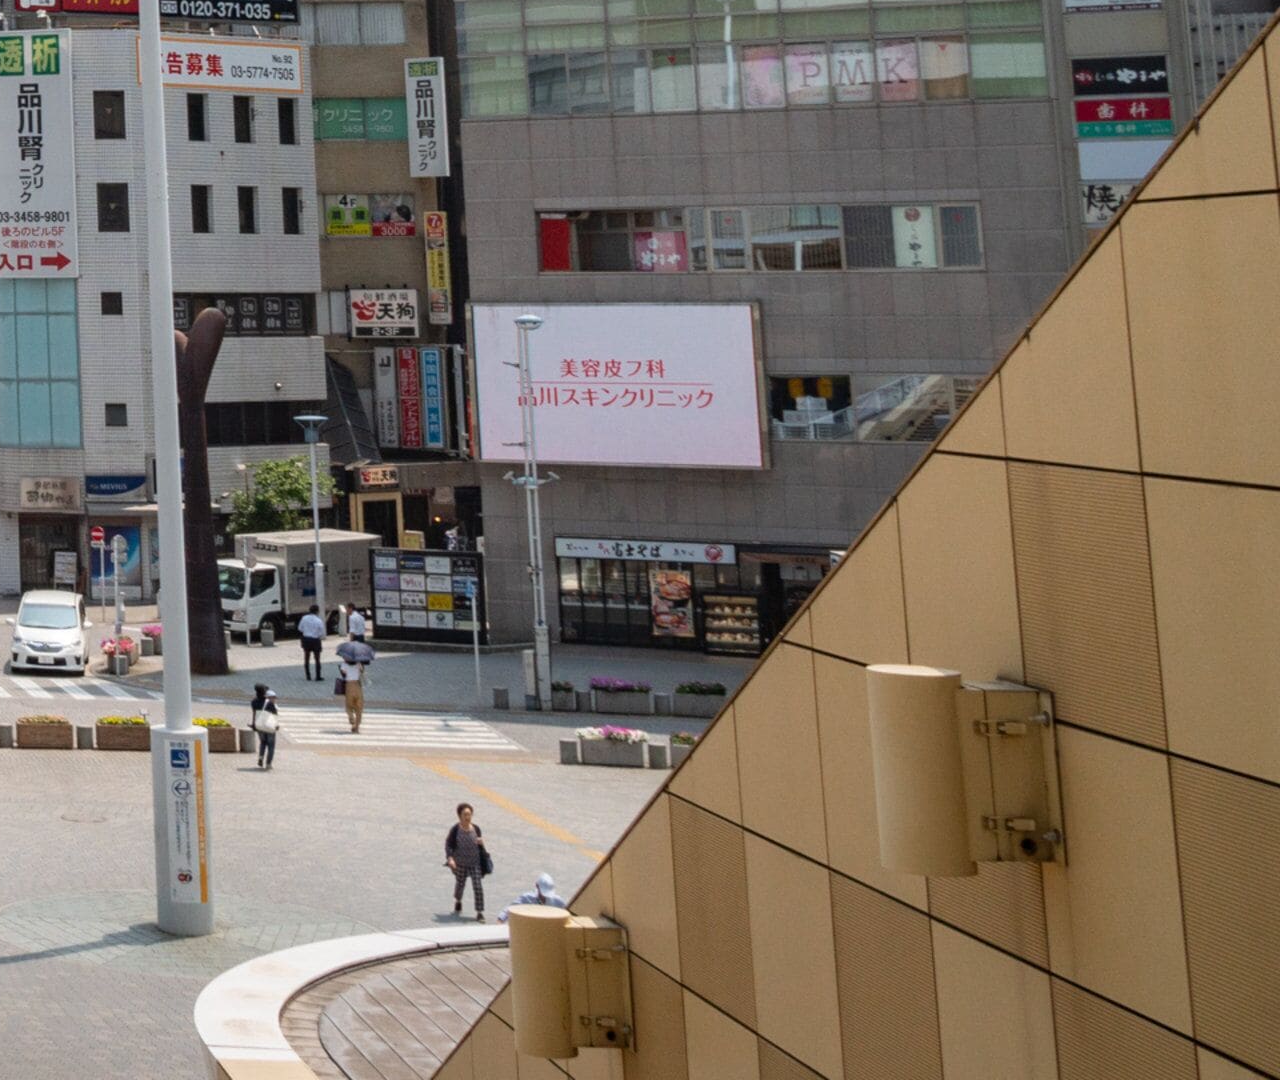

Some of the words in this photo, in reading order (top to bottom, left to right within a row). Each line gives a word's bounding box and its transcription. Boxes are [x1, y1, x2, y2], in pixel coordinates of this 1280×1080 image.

[179, 0, 271, 21] 0120-371-035
[159, 52, 225, 78] 告募集
[270, 54, 294, 65] No.92
[230, 65, 295, 81] 03-5774-7505
[797, 57, 909, 88] PMK
[1095, 102, 1149, 120] 歯科
[375, 302, 416, 320] 天狗
[559, 358, 667, 379] 美容皮フ科
